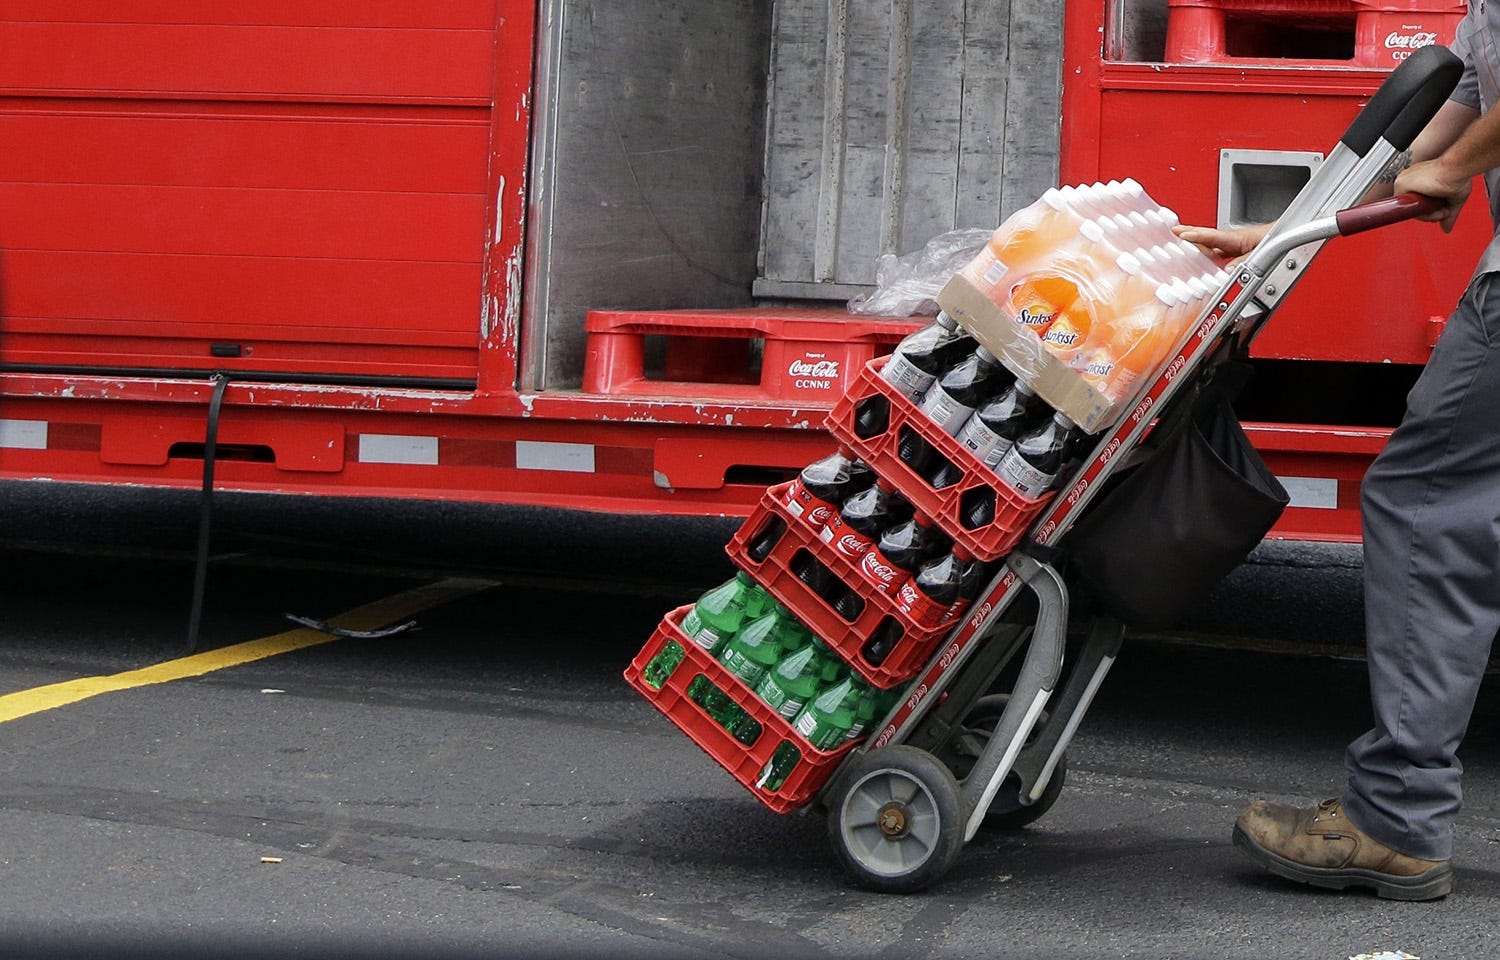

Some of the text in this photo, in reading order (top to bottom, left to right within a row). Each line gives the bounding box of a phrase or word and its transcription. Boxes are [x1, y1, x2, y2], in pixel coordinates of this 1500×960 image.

[788, 360, 839, 377] Coca-Cola
[1071, 353, 1113, 376] Snkist
[795, 380, 831, 389] CCNNE
[865, 552, 898, 581] Coca-Cola
